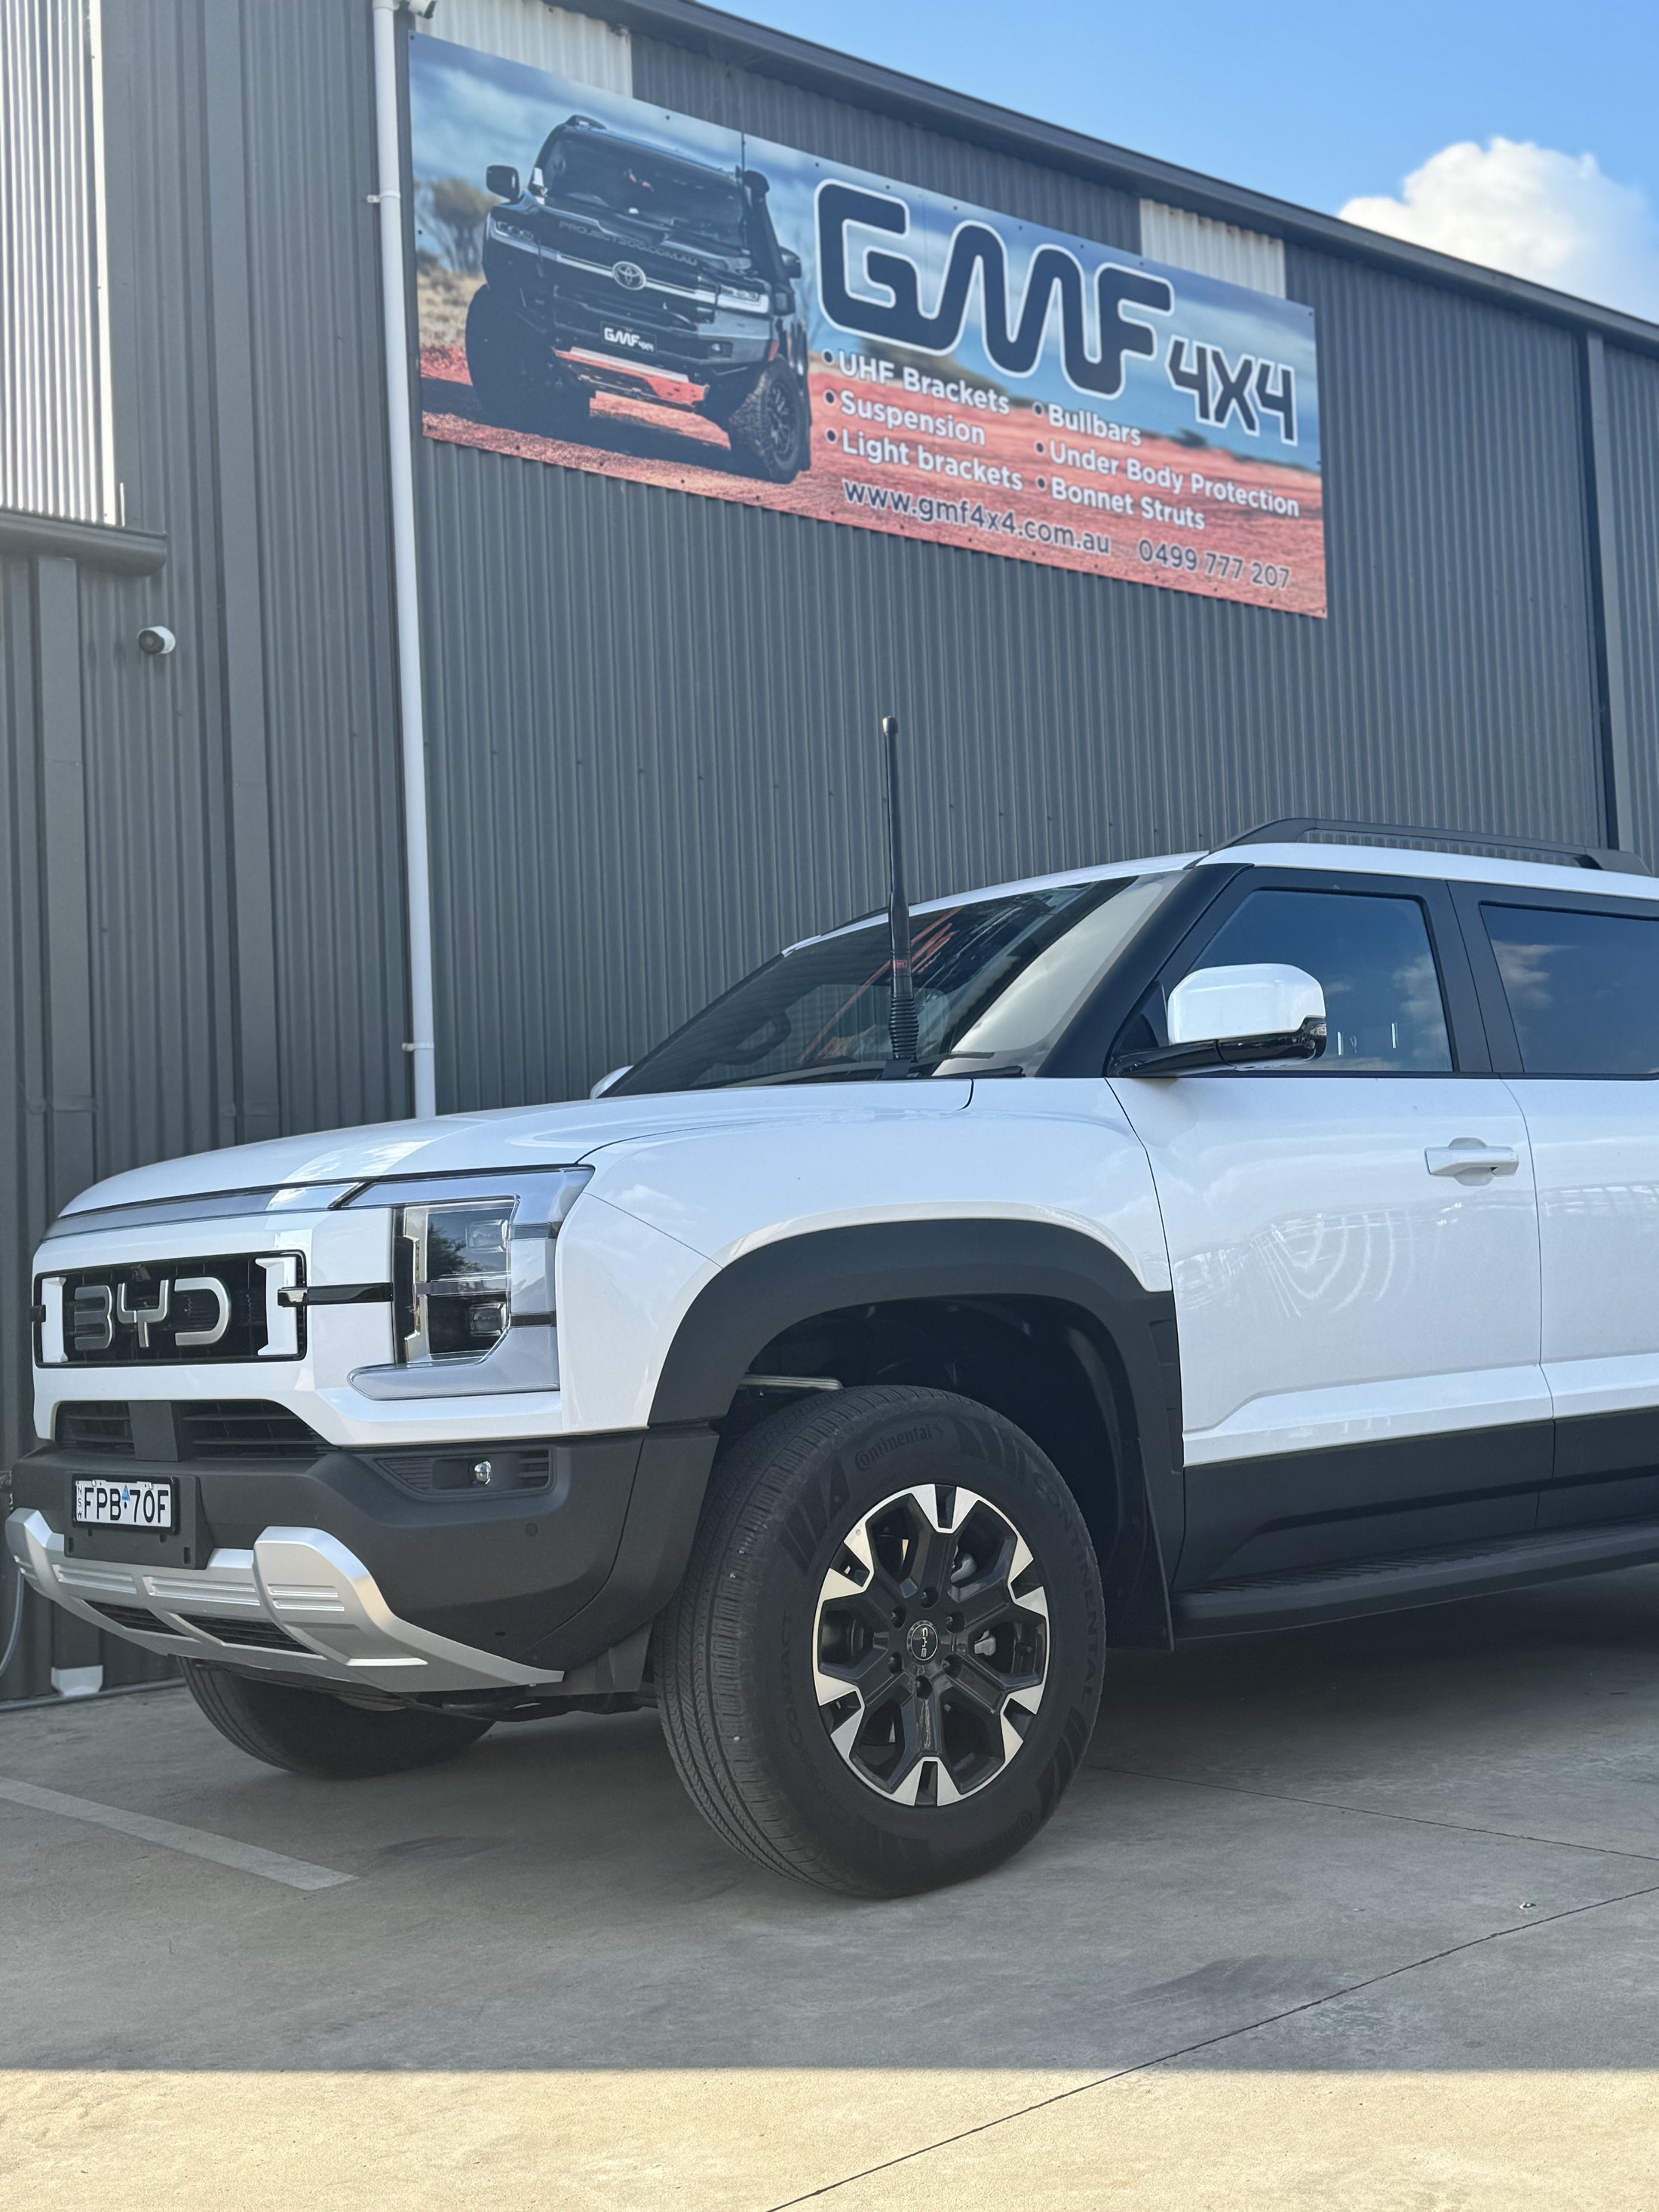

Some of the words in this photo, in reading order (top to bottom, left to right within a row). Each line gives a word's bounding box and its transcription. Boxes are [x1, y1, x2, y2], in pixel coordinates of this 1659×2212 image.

[814, 179, 1176, 400] GMF
[604, 327, 640, 347] GMF
[839, 350, 895, 384] UHF
[903, 366, 1011, 415] Brackets
[839, 389, 986, 446] Suspension
[1048, 403, 1142, 446] Bullbars
[842, 428, 909, 466] Light
[917, 444, 1024, 491] brackets
[1049, 440, 1120, 475] Under
[1127, 458, 1183, 495] Body
[1191, 473, 1299, 517] Protection
[843, 480, 1111, 554] www.gmf4x4.com.au
[1051, 477, 1133, 515] Bonnet
[1140, 496, 1206, 529] Struts
[1138, 539, 1198, 571] 0499
[1205, 552, 1243, 580] 777
[1251, 563, 1290, 589] 207
[74, 1276, 229, 1351] BYD
[854, 1422, 933, 1471] Continental
